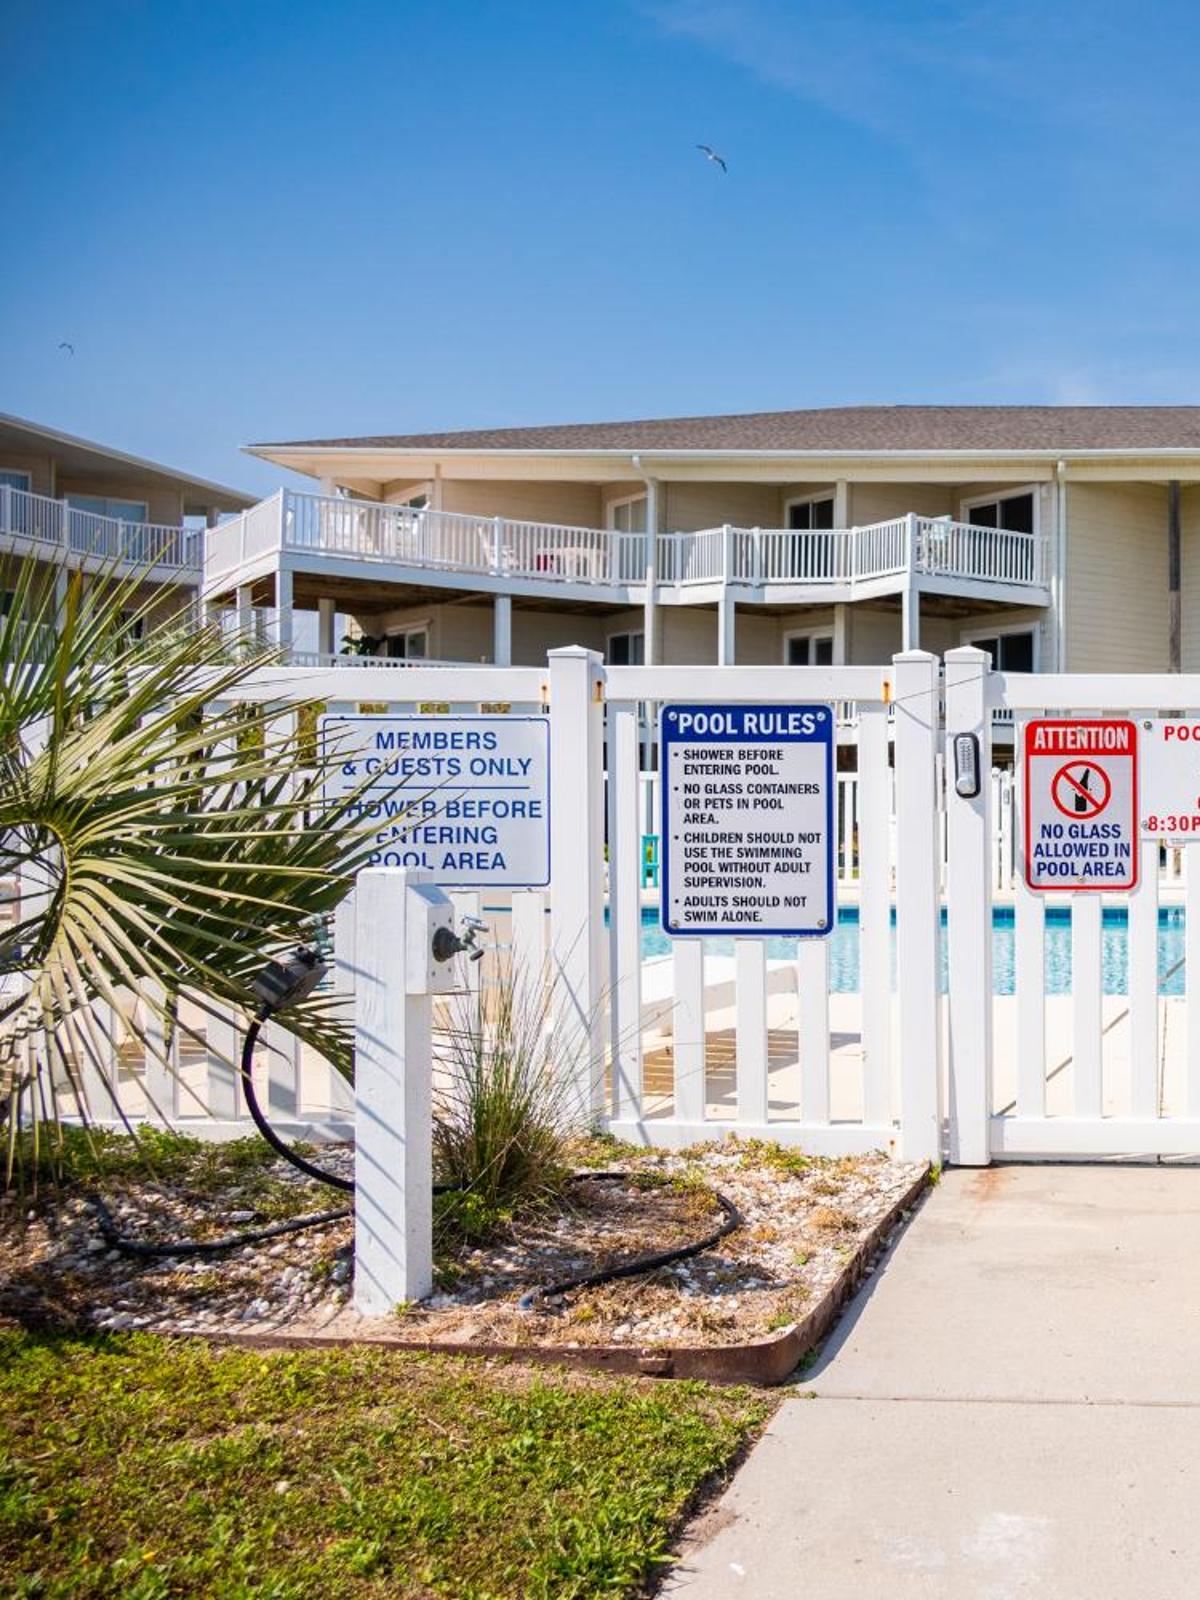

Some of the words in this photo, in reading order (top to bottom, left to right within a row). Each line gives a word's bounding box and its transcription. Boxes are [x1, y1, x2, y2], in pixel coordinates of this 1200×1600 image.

[679, 713, 738, 734] POOL
[744, 713, 816, 735] RULES
[376, 732, 497, 750] MEMBERS
[1034, 727, 1129, 750] ATTENTION
[683, 750, 734, 761] SHOWER
[738, 750, 784, 761] BEFORE
[342, 761, 356, 776] &
[365, 758, 462, 776] GUESTS
[470, 758, 532, 776] ONLY
[684, 765, 741, 776] ENTERING
[745, 765, 779, 776] POOL.
[684, 784, 700, 795] NO
[704, 784, 743, 795] GLASS
[747, 784, 820, 795] CONTAINERS
[332, 800, 436, 818] HOWER
[446, 801, 542, 818] BEFORE
[684, 799, 700, 810] OR
[704, 799, 733, 810] PETS
[737, 799, 749, 810] IN
[753, 799, 784, 810] POOL
[684, 814, 719, 825] AREA.
[376, 826, 498, 844] ENTERING
[1041, 824, 1064, 839] NO
[1069, 824, 1121, 839] GLASS
[684, 833, 743, 844] CHILDREN
[747, 833, 794, 844] SHOULD
[798, 833, 821, 844] NOT
[684, 848, 707, 859] USE
[711, 848, 733, 859] THE
[737, 848, 802, 859] SWIMMING
[1034, 843, 1109, 858] ALLOWED
[1115, 843, 1130, 858] IN
[369, 852, 434, 870] POOL
[441, 852, 506, 870] AREA
[684, 862, 714, 874] POOL
[718, 862, 771, 874] WITHOUT
[774, 862, 811, 874] ADULT
[1037, 862, 1079, 877] POOL
[1083, 862, 1126, 877] AREA
[684, 877, 766, 888] SUPERVISION.
[684, 896, 728, 907] ADULTS
[732, 896, 780, 907] SHOULD
[784, 896, 807, 907] NOT
[684, 911, 718, 922] SWIM
[721, 911, 762, 922] ALONE.
